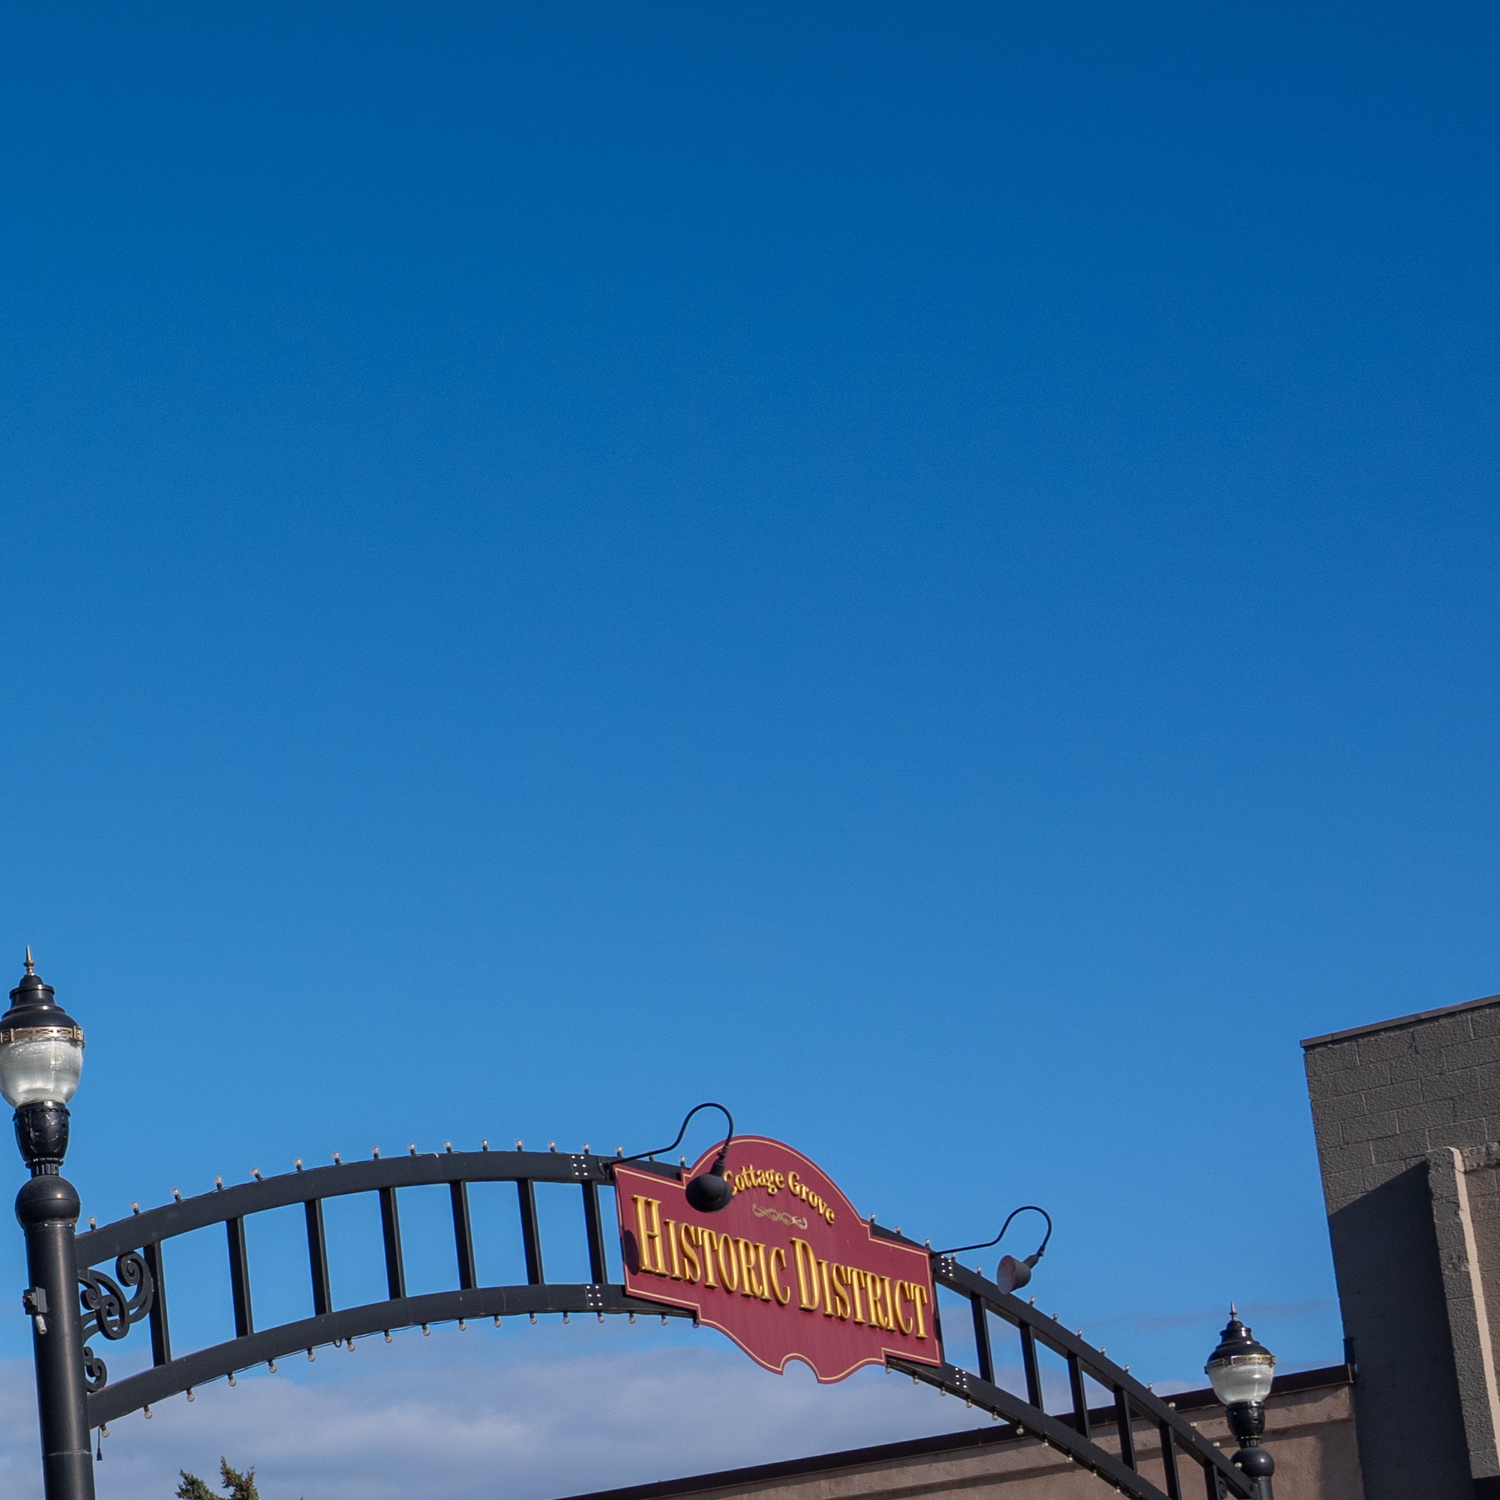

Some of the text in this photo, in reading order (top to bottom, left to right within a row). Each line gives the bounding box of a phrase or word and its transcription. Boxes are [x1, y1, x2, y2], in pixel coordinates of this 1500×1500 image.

[788, 1171, 836, 1226] Grove
[631, 1193, 929, 1340] HISTORIC DISTRICT
